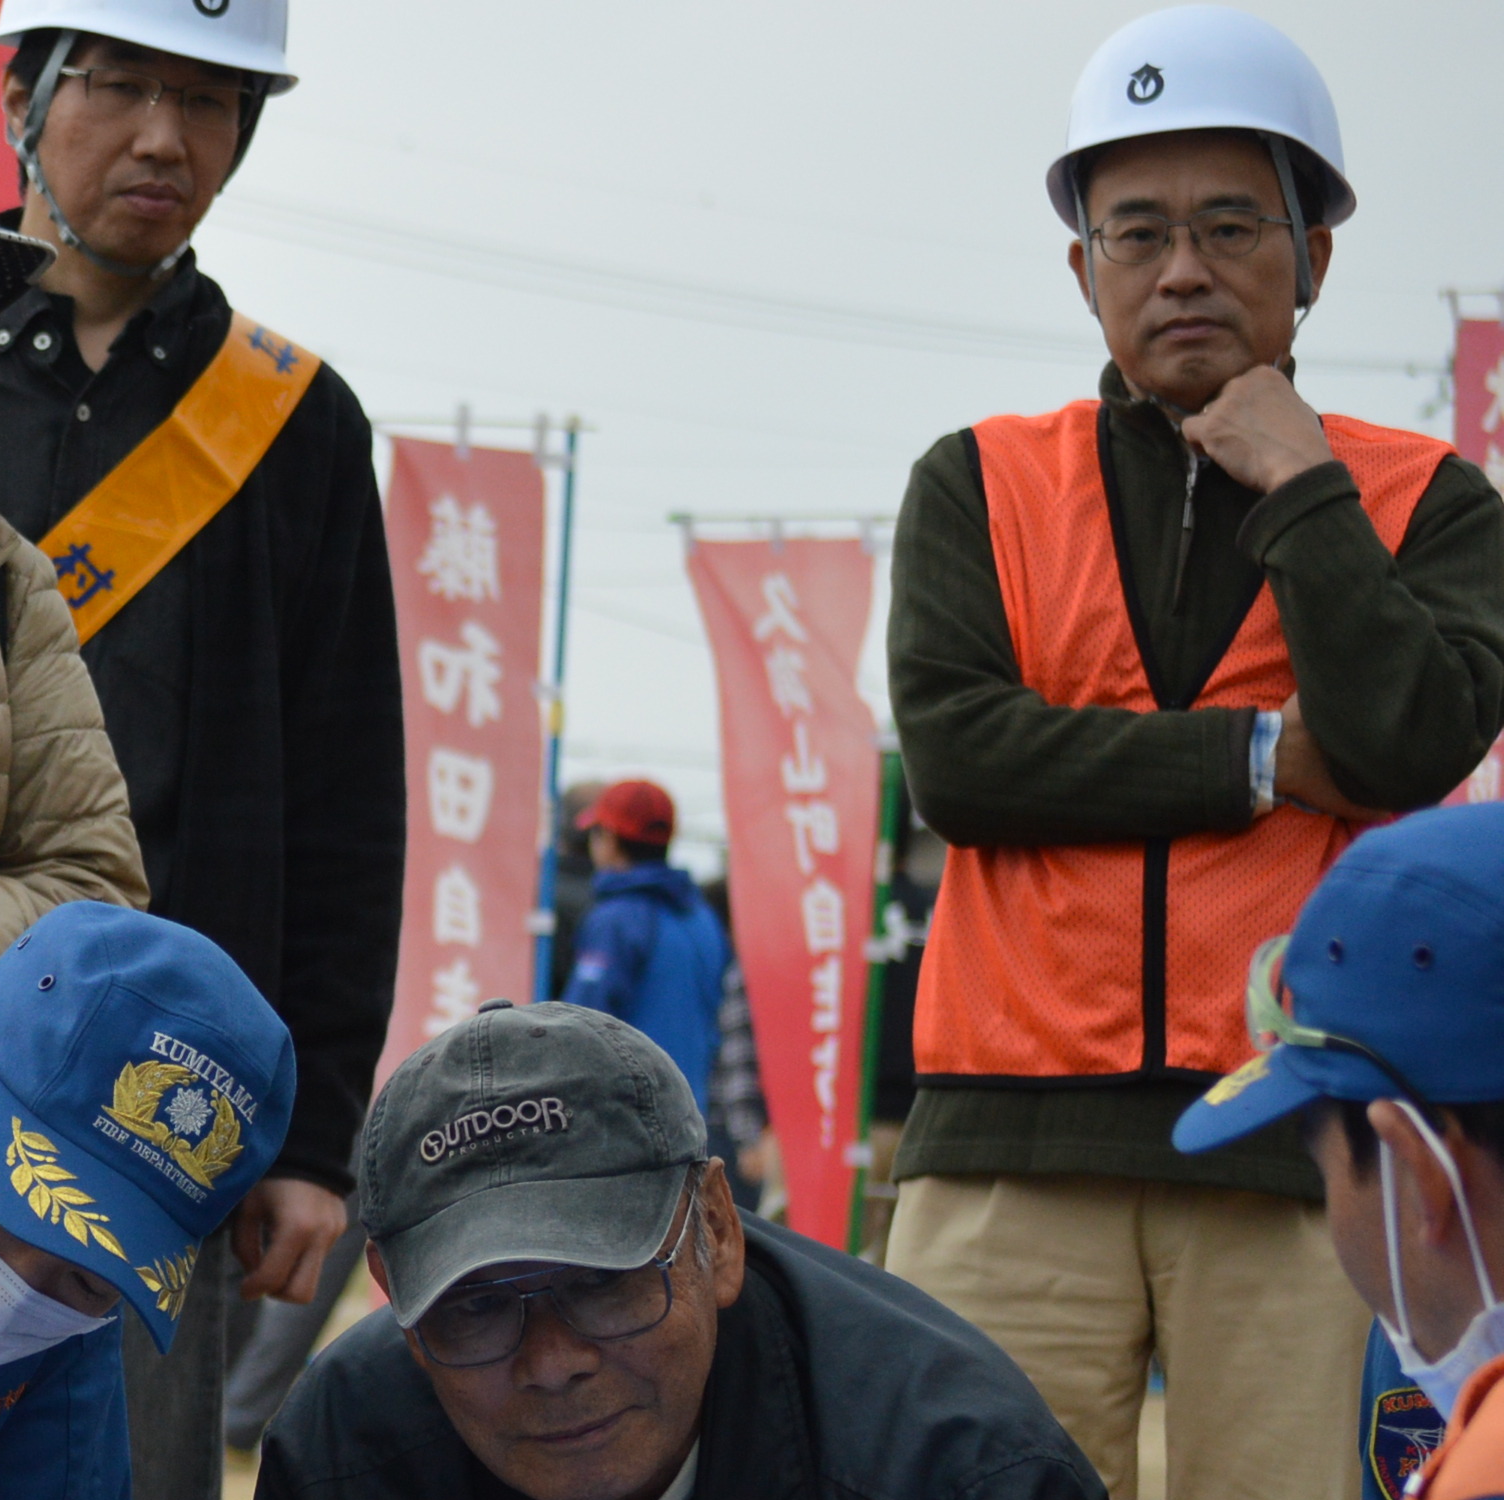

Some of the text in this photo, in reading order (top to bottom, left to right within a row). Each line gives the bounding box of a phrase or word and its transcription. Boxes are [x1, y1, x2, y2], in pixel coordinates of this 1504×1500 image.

[53, 540, 115, 610] 村
[149, 1031, 259, 1125] KUMIYAMA
[92, 1114, 208, 1204] FIRE DEPARTMENT
[420, 1096, 569, 1162] OUTDOOR
[448, 1126, 540, 1159] PRODUCTS
